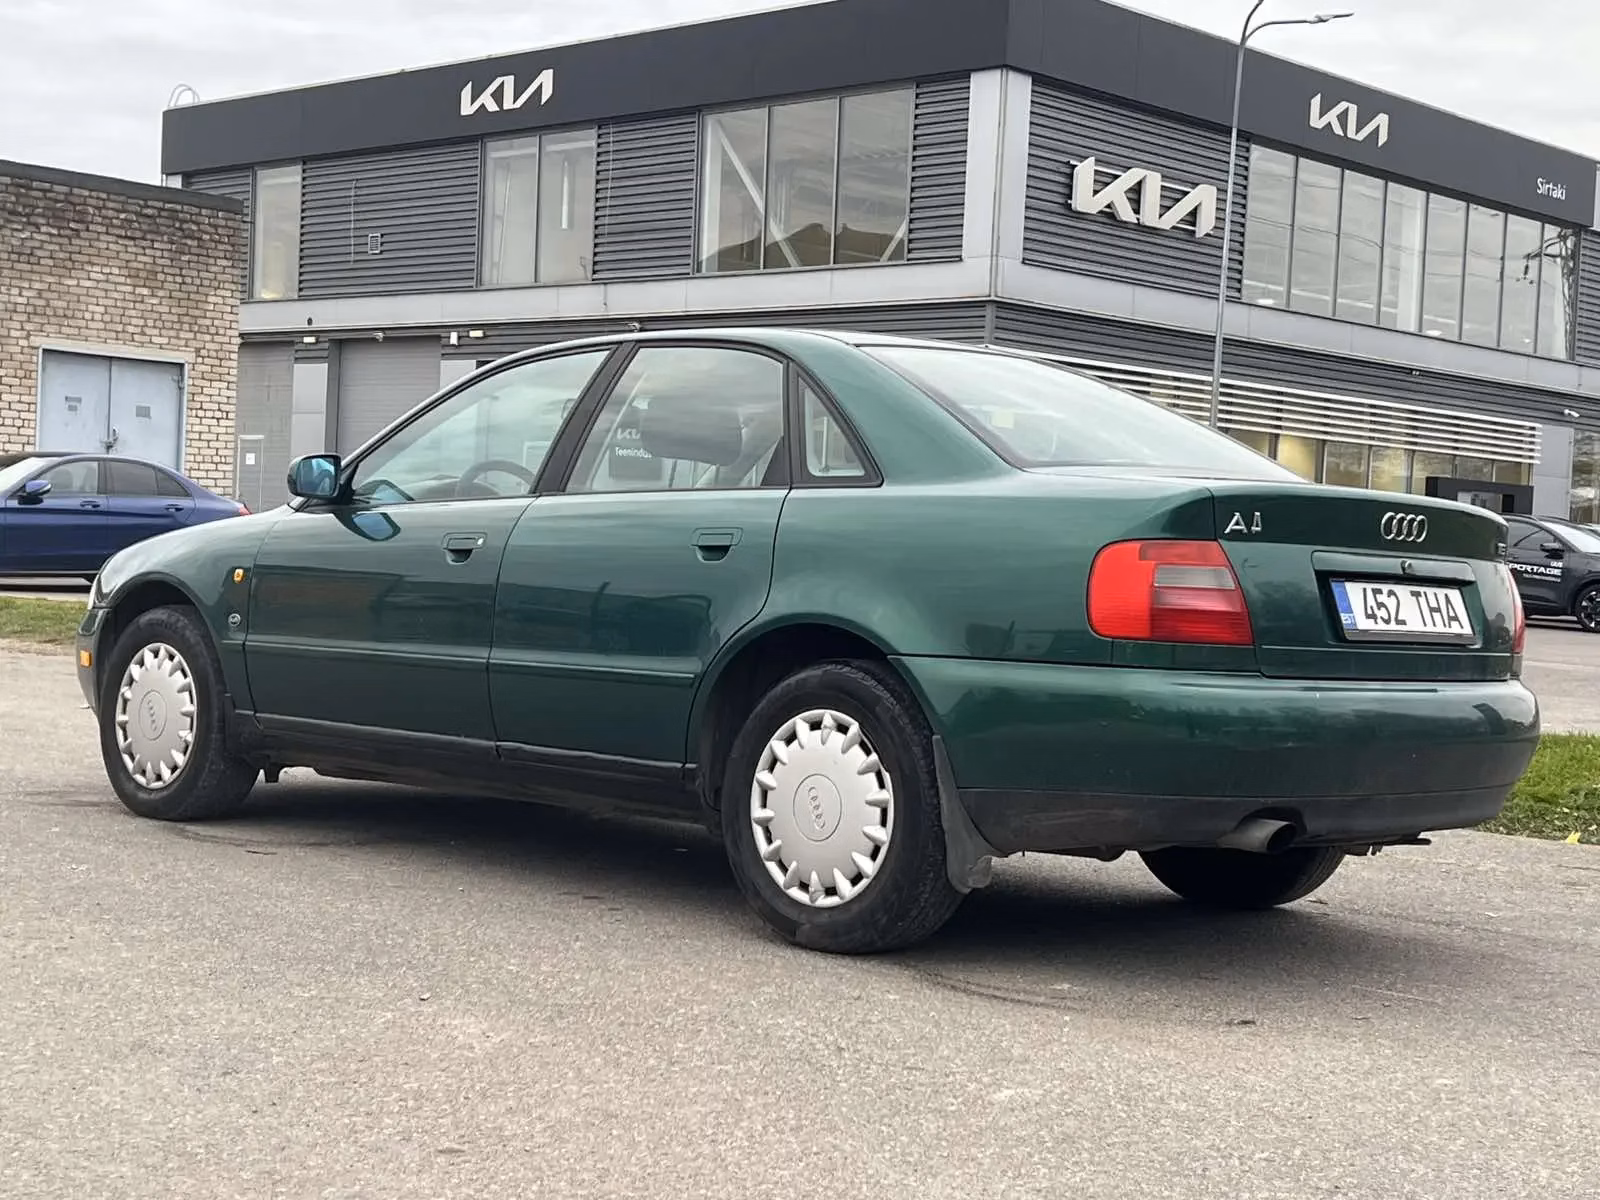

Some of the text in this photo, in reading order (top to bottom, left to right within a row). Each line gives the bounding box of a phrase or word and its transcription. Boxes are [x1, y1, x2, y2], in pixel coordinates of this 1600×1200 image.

[460, 68, 554, 116] KIA
[1309, 92, 1389, 147] KIA
[1072, 156, 1217, 238] KIA
[1536, 177, 1566, 200] Sirtaki
[1224, 511, 1263, 534] A4
[1506, 561, 1562, 576] PORTAGE
[1362, 587, 1464, 629] 452 THA
